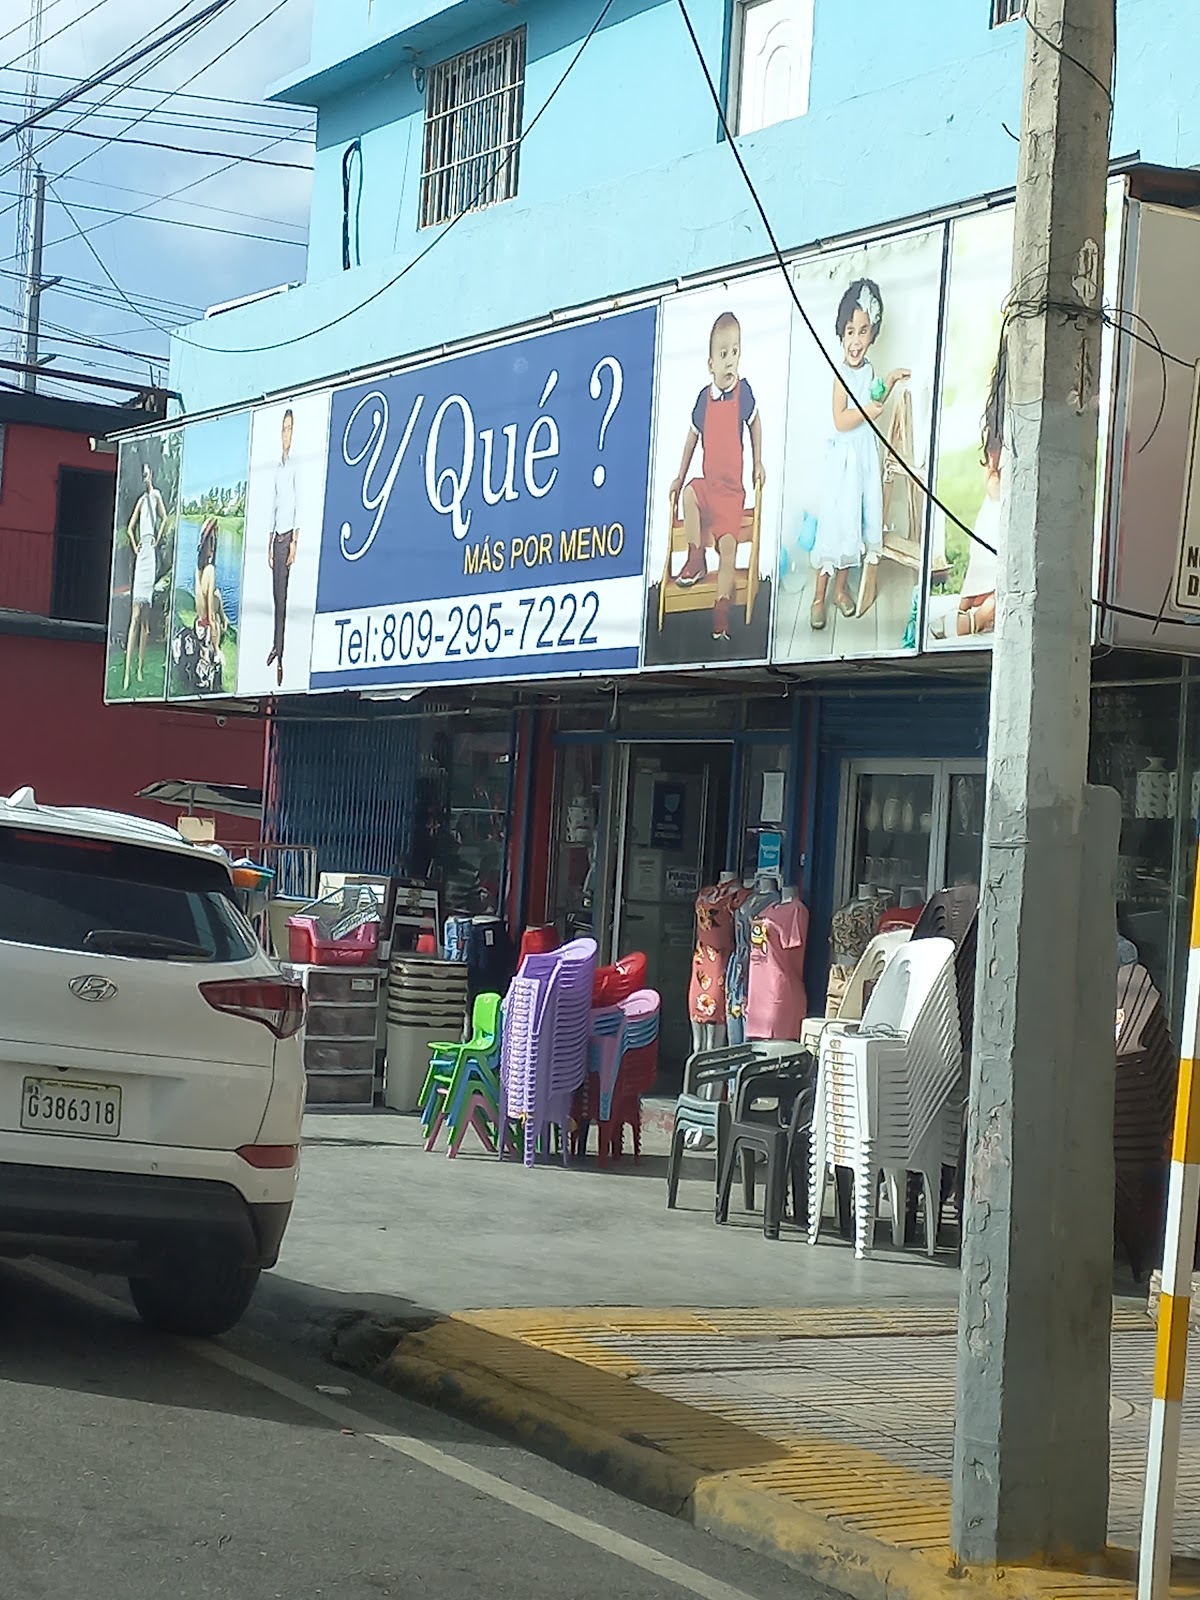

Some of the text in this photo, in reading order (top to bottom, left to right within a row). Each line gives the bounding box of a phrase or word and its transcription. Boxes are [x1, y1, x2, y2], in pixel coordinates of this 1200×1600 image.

[425, 369, 560, 540] Qué
[463, 521, 625, 575] MÁS POR MENO
[28, 1095, 115, 1125] G386318
